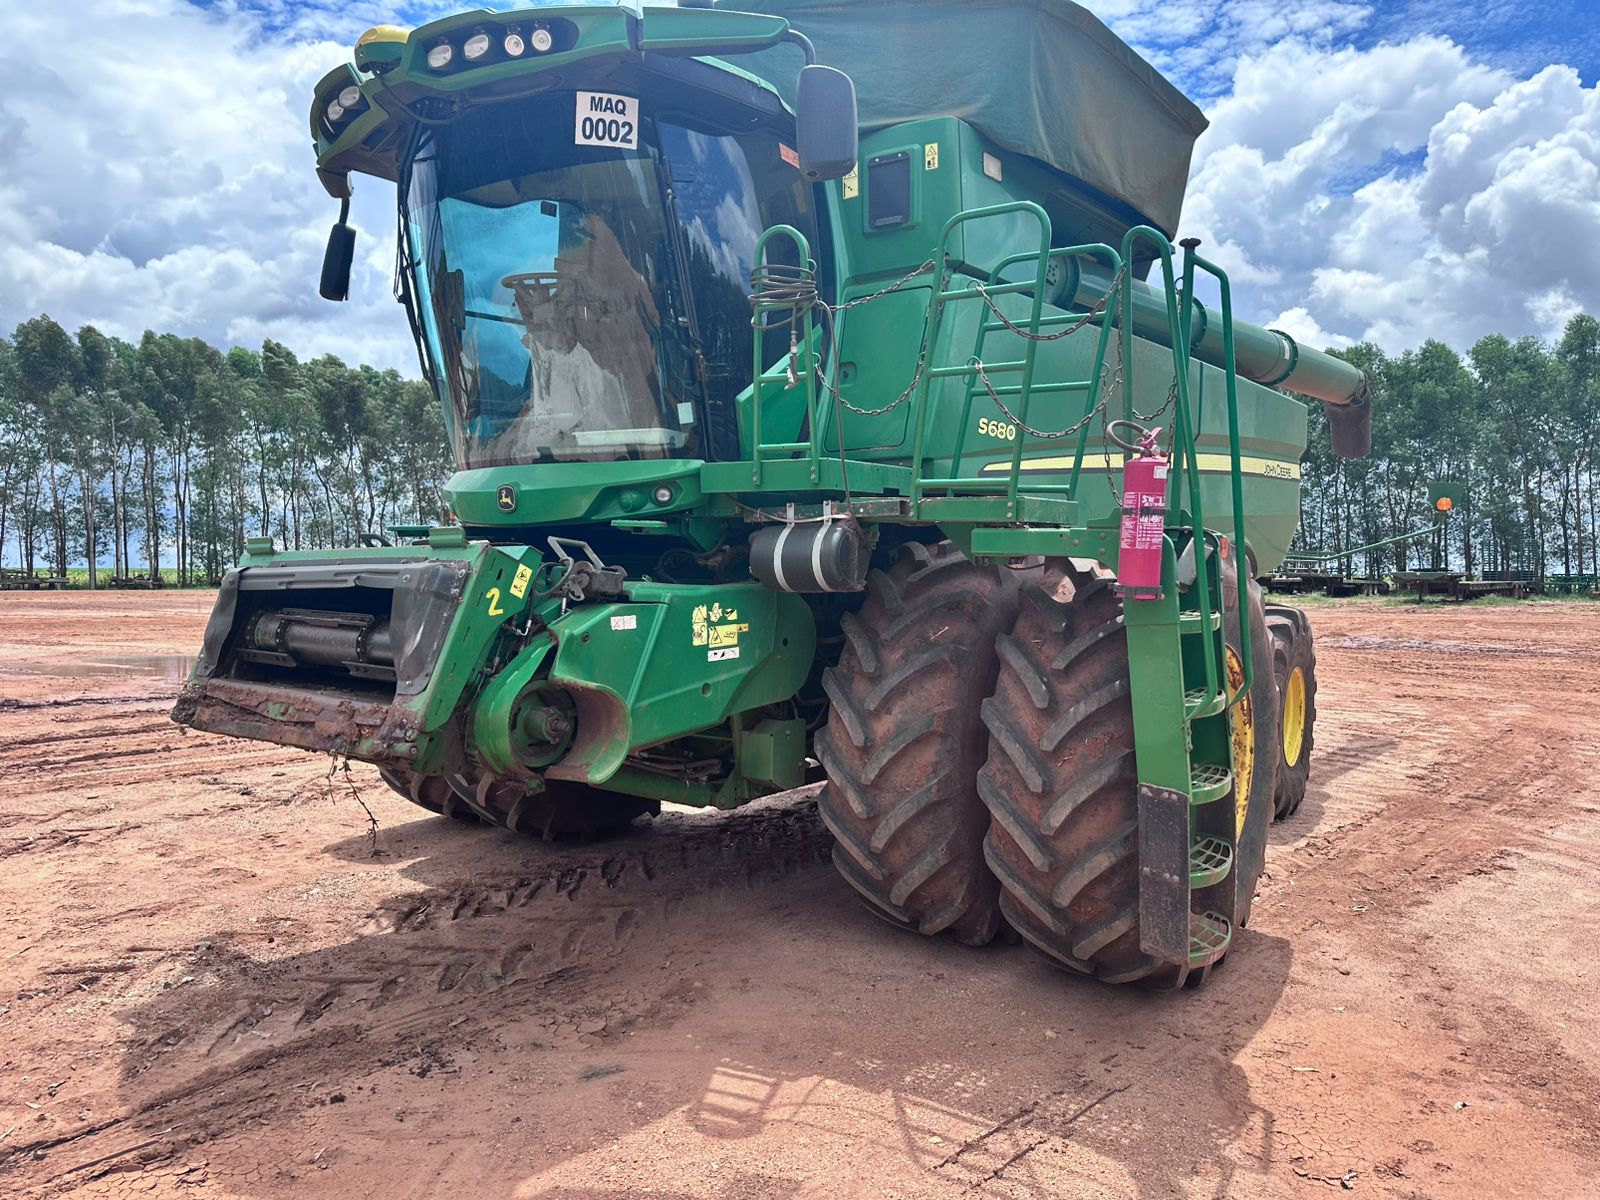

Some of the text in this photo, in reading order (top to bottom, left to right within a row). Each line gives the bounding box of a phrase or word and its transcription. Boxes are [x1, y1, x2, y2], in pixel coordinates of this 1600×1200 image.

[590, 96, 627, 116] MAQ
[582, 116, 633, 144] 0002
[978, 417, 1016, 441] S680
[1263, 462, 1291, 478] JOHN DEERE
[485, 587, 504, 616] 2
